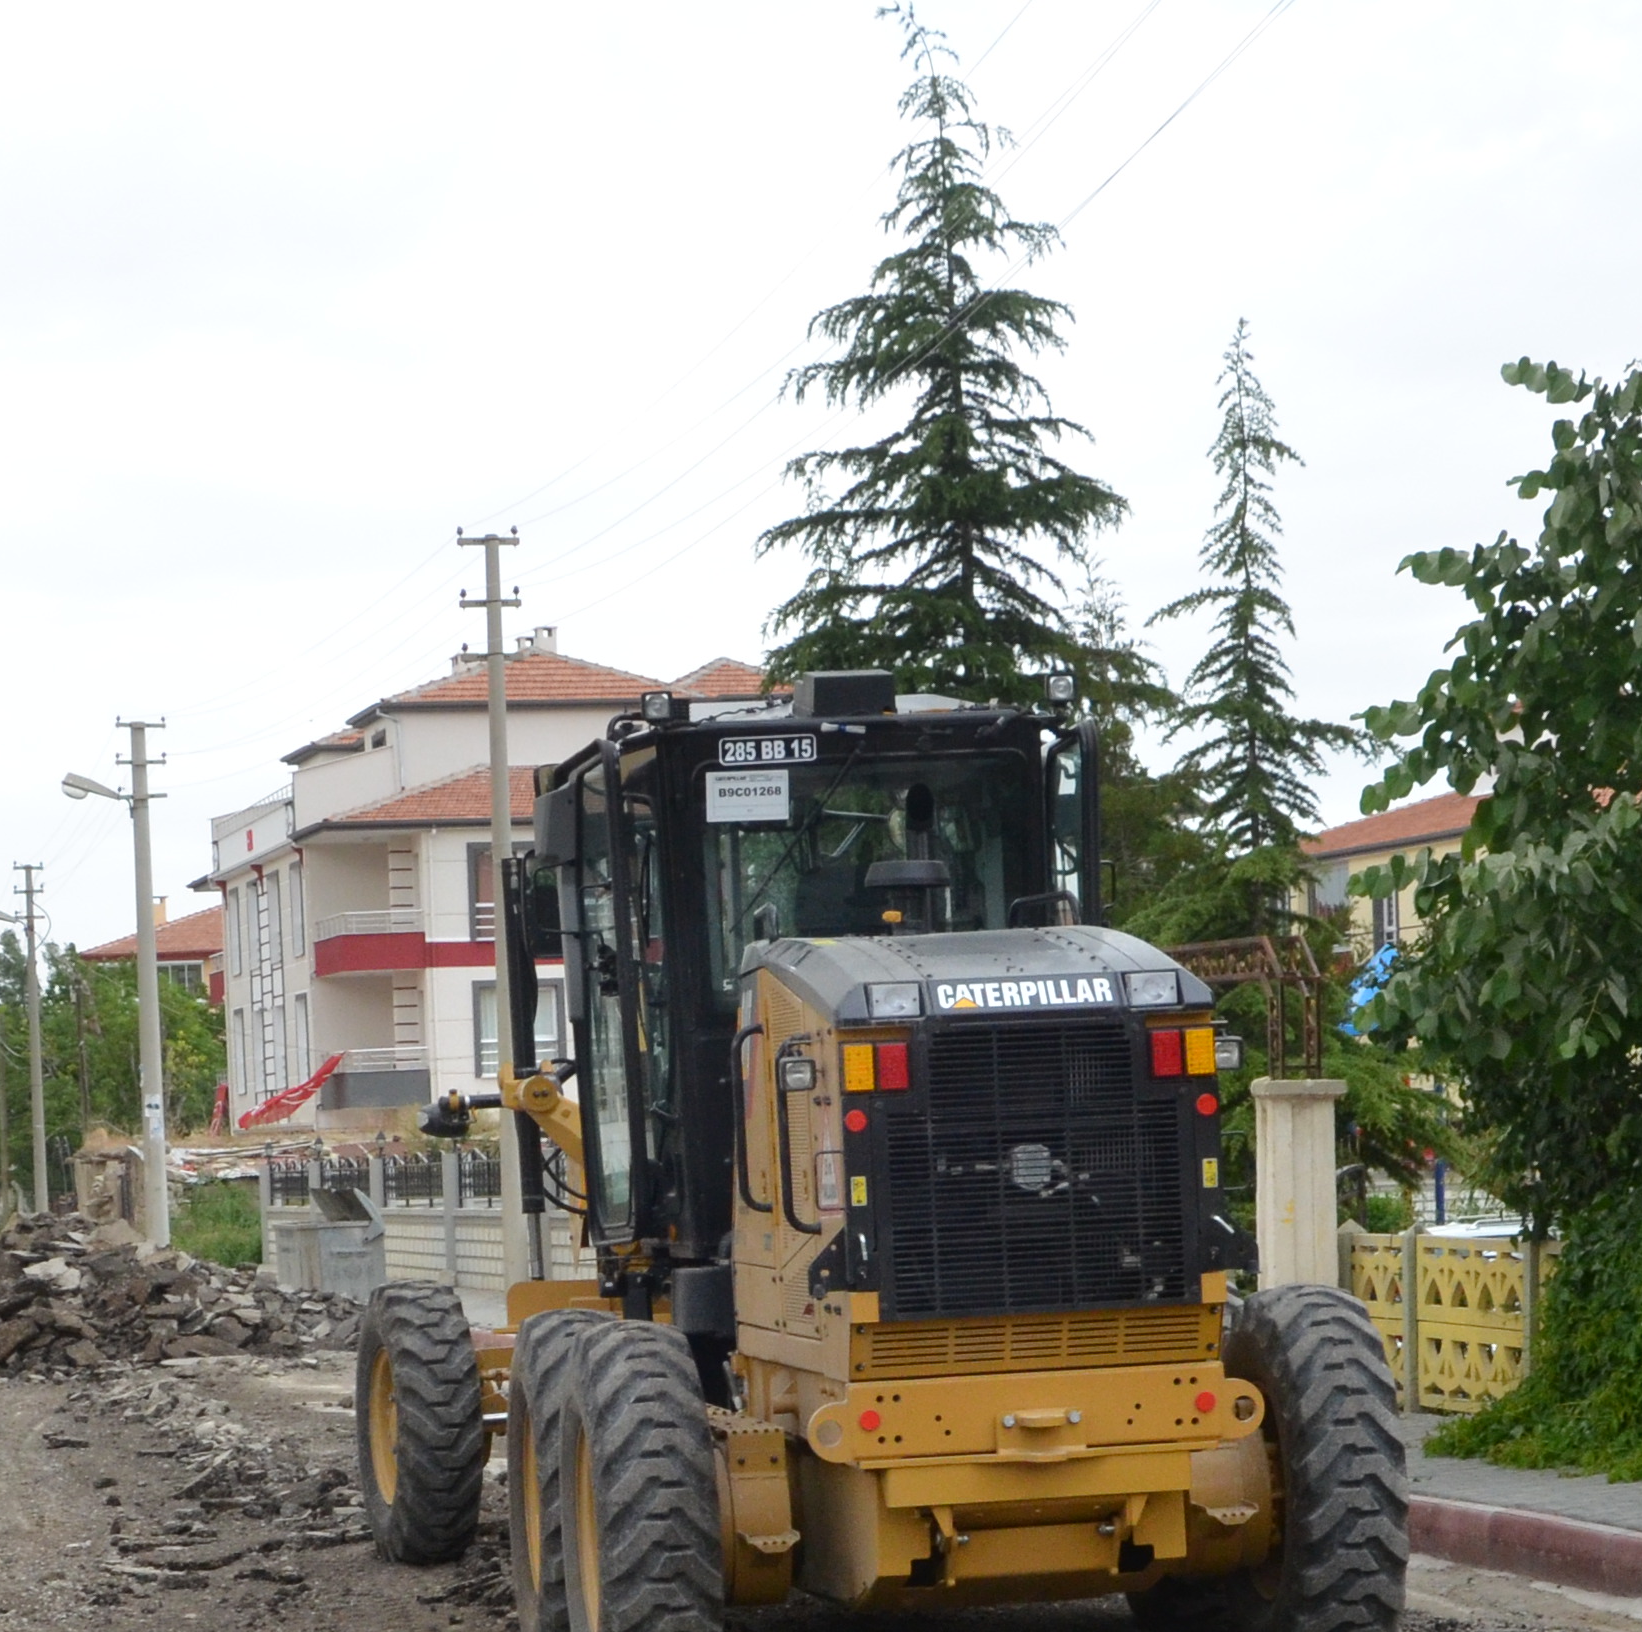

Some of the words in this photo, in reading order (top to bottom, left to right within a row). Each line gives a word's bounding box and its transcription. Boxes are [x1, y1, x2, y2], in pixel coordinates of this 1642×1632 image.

[724, 742, 756, 762] 285
[760, 740, 786, 760] BB
[790, 738, 812, 758] 15
[718, 786, 782, 798] B9C01268
[936, 977, 1114, 1010] CATERPILLAR
